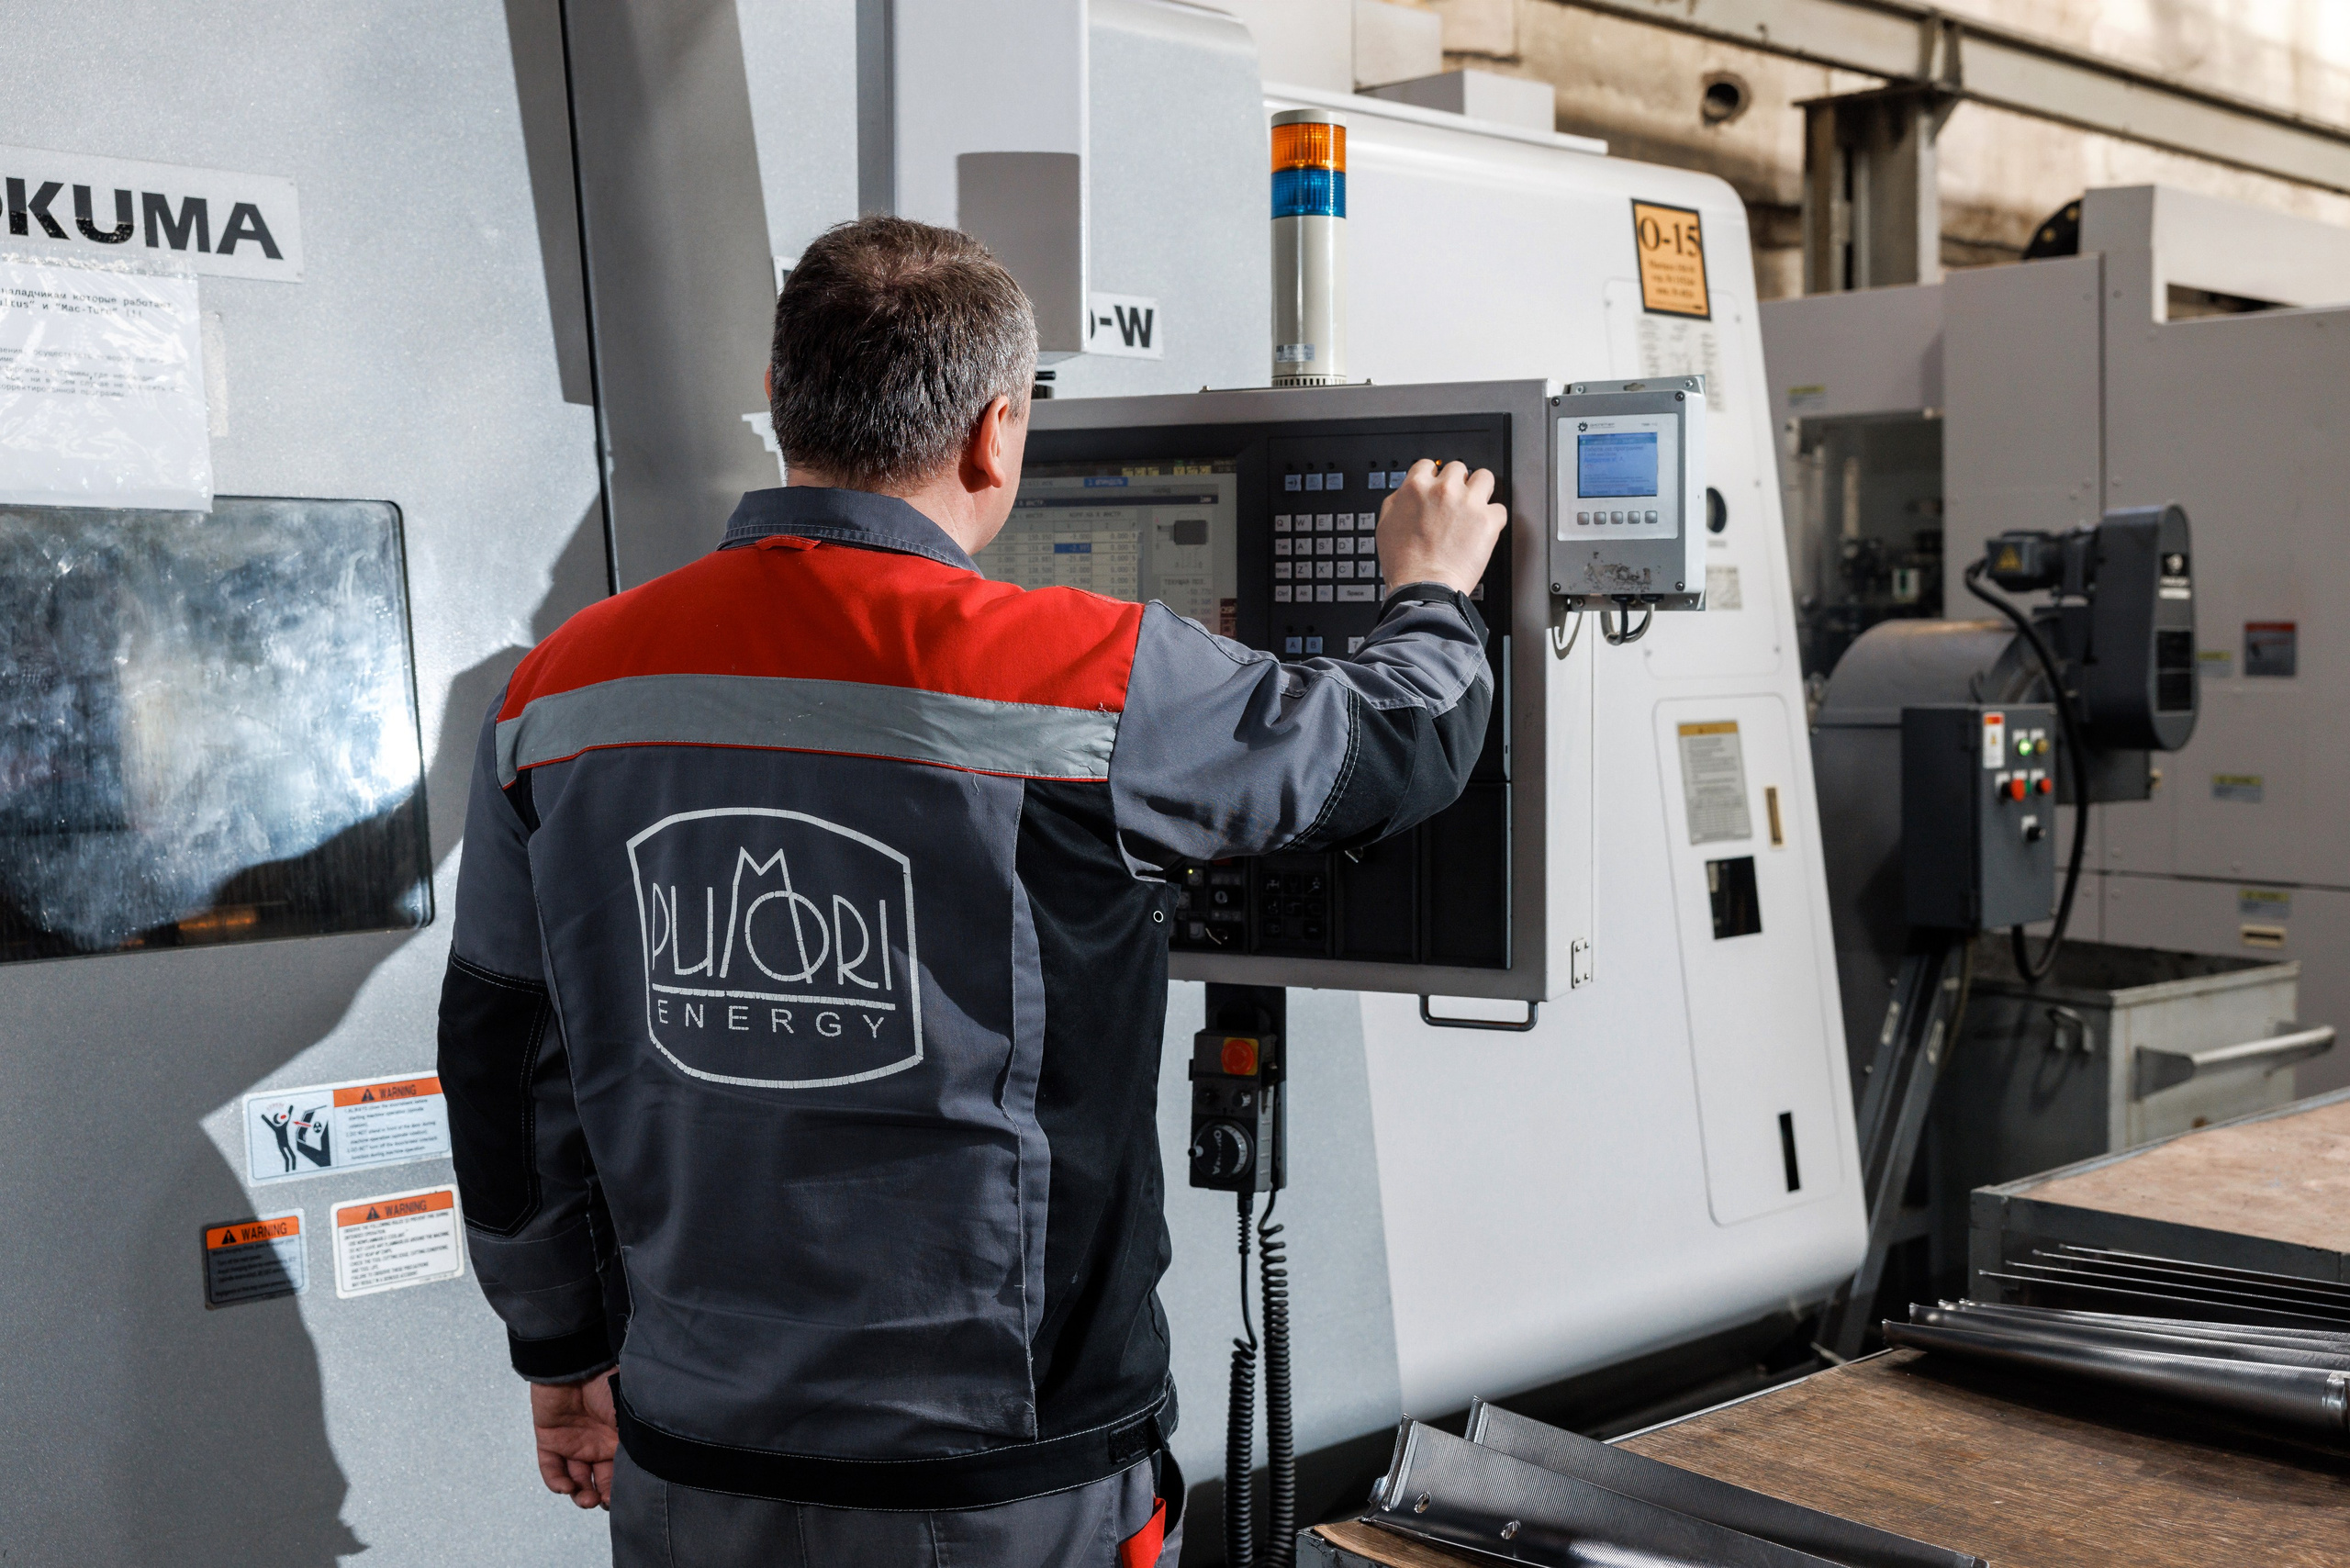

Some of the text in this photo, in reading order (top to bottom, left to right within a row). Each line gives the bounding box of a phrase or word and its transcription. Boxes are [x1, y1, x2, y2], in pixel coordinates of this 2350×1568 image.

[0, 176, 284, 261] KUMA
[1090, 304, 1154, 349] -W
[1276, 519, 1283, 527] Q
[1318, 518, 1324, 526] E
[1338, 518, 1346, 526] R
[1360, 517, 1366, 525] T
[1318, 542, 1325, 550] S
[1338, 542, 1346, 550] D
[1360, 541, 1366, 549] F
[1297, 566, 1304, 574] Z
[1338, 566, 1346, 574] C
[1360, 565, 1367, 573] V
[658, 999, 884, 1038] ENERGY
[379, 1084, 417, 1099] WARNING
[385, 1200, 427, 1216] WARNING
[241, 1222, 287, 1241] WARNING
